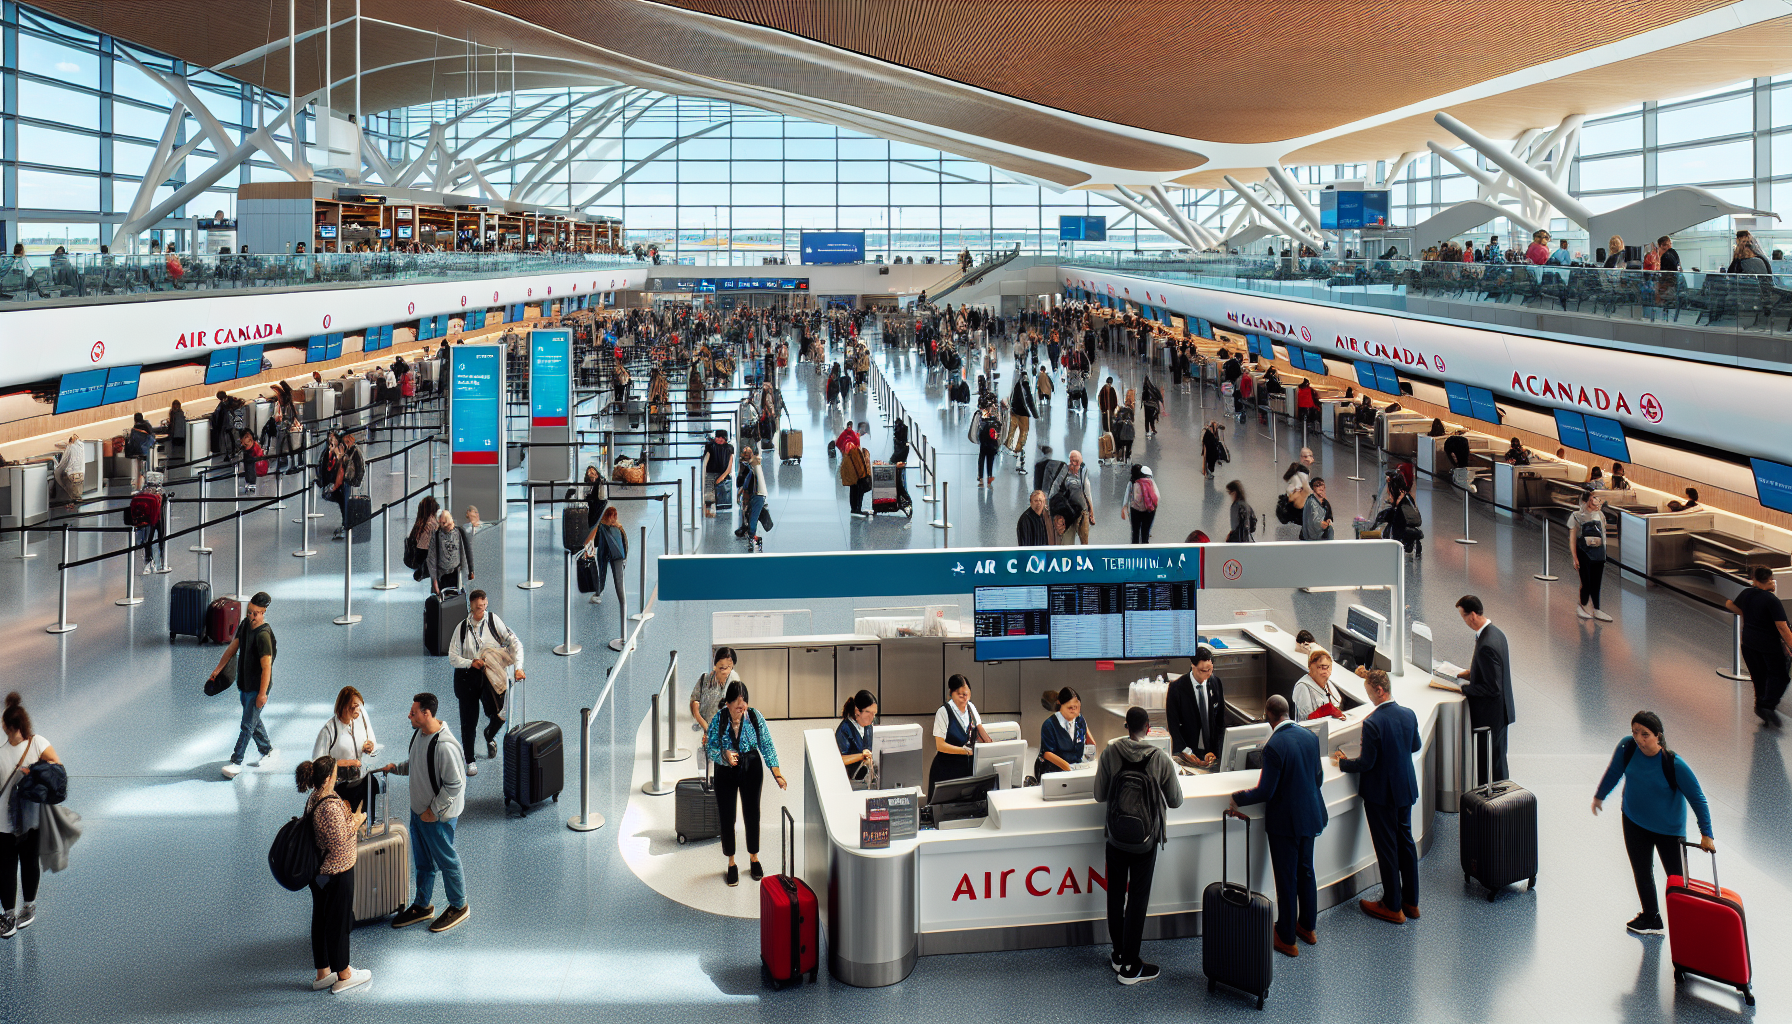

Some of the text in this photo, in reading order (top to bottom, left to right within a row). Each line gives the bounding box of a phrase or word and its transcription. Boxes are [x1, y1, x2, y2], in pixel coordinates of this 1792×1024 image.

[175, 323, 283, 350] AIR CANADA
[1511, 370, 1632, 416] ACANADA
